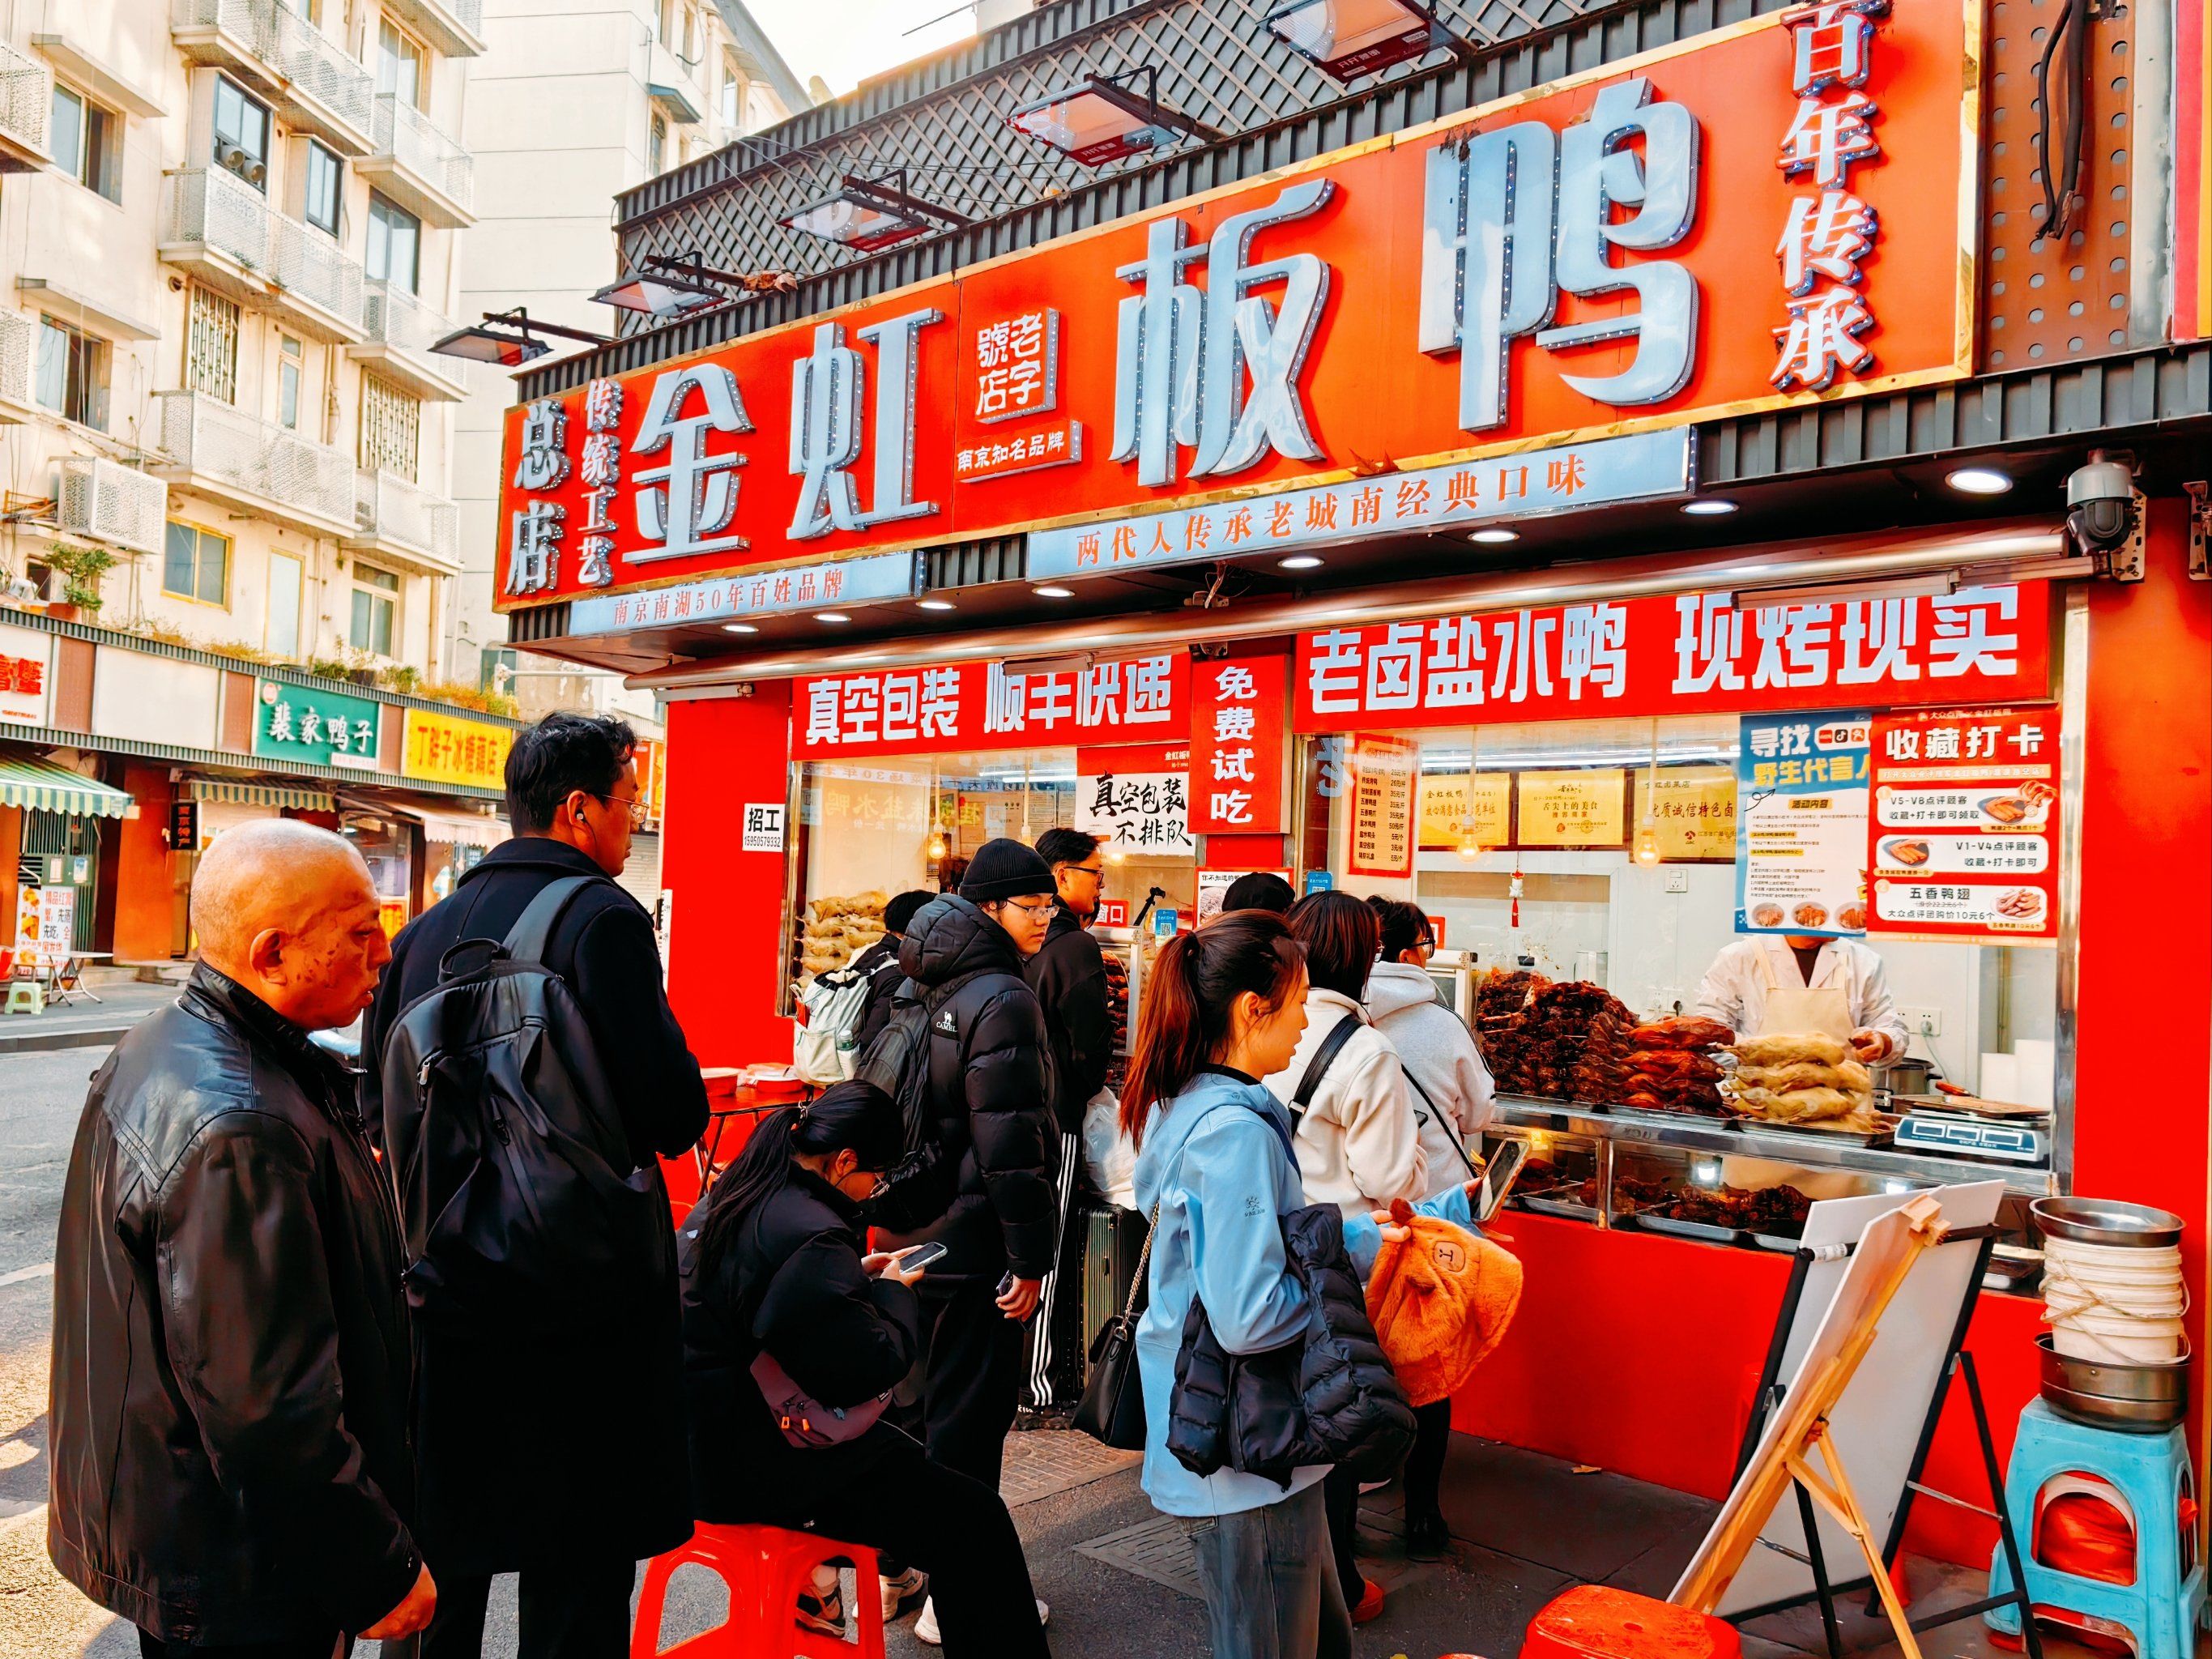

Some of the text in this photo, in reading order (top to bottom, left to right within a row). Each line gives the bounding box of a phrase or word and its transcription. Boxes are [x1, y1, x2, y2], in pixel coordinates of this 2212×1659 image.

[1771, 0, 1879, 390] 百年传承
[957, 430, 1065, 471] 南京知名品牌
[504, 399, 569, 596] 总店
[577, 378, 624, 587] 传统工艺
[1076, 453, 1586, 567] 两代人传承老城南经典口味
[613, 569, 844, 625] 南京南湖50年百姓品牌
[1308, 584, 2018, 714] 老卤盐水鸭 现烤现卖
[806, 655, 1172, 744] 真空包装 顺丰快递
[1209, 666, 1258, 823] 免费试吃
[1750, 723, 1810, 757] 寻找
[1886, 723, 2044, 761] 收藏打卡
[1754, 753, 1870, 787] 野生代言人
[1089, 770, 1186, 817] 真空包装
[1792, 800, 1829, 808] 活动内容
[1890, 796, 1967, 805] V5-V8点评顾客
[748, 808, 780, 832] 招工
[1889, 810, 1980, 820] 收藏+打卡即可领取
[744, 836, 781, 847] 15950579332
[1114, 818, 1192, 847] 不排队
[1956, 842, 2038, 851] V1-V4点评顾客
[1964, 858, 2037, 868] 收藏+打卡即可
[1910, 888, 1971, 900] 五香鸭翅
[1888, 910, 1995, 920] 大众点评团购价10元6个
[936, 1021, 958, 1033] CAMEL
